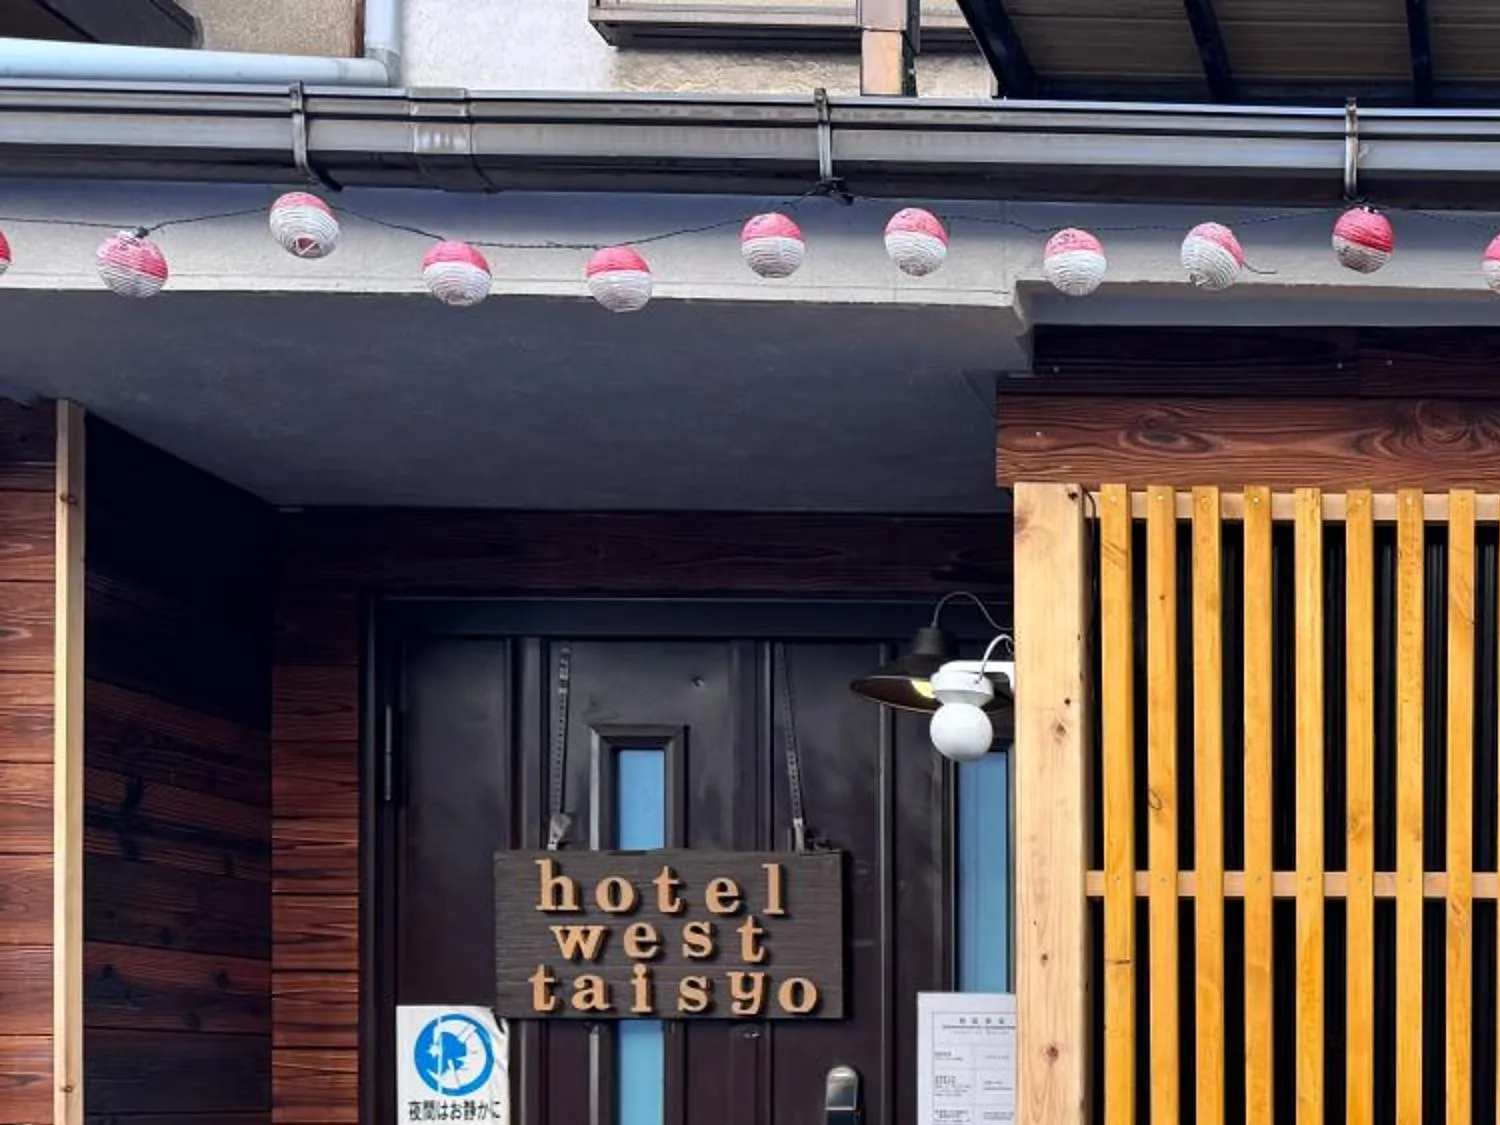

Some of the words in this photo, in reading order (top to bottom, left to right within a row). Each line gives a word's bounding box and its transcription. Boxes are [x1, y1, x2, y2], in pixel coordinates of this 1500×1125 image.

[535, 859, 785, 915] hotel
[550, 915, 767, 963] west
[529, 963, 819, 1015] taisyo
[408, 1099, 501, 1121] 夜間はお静かに
